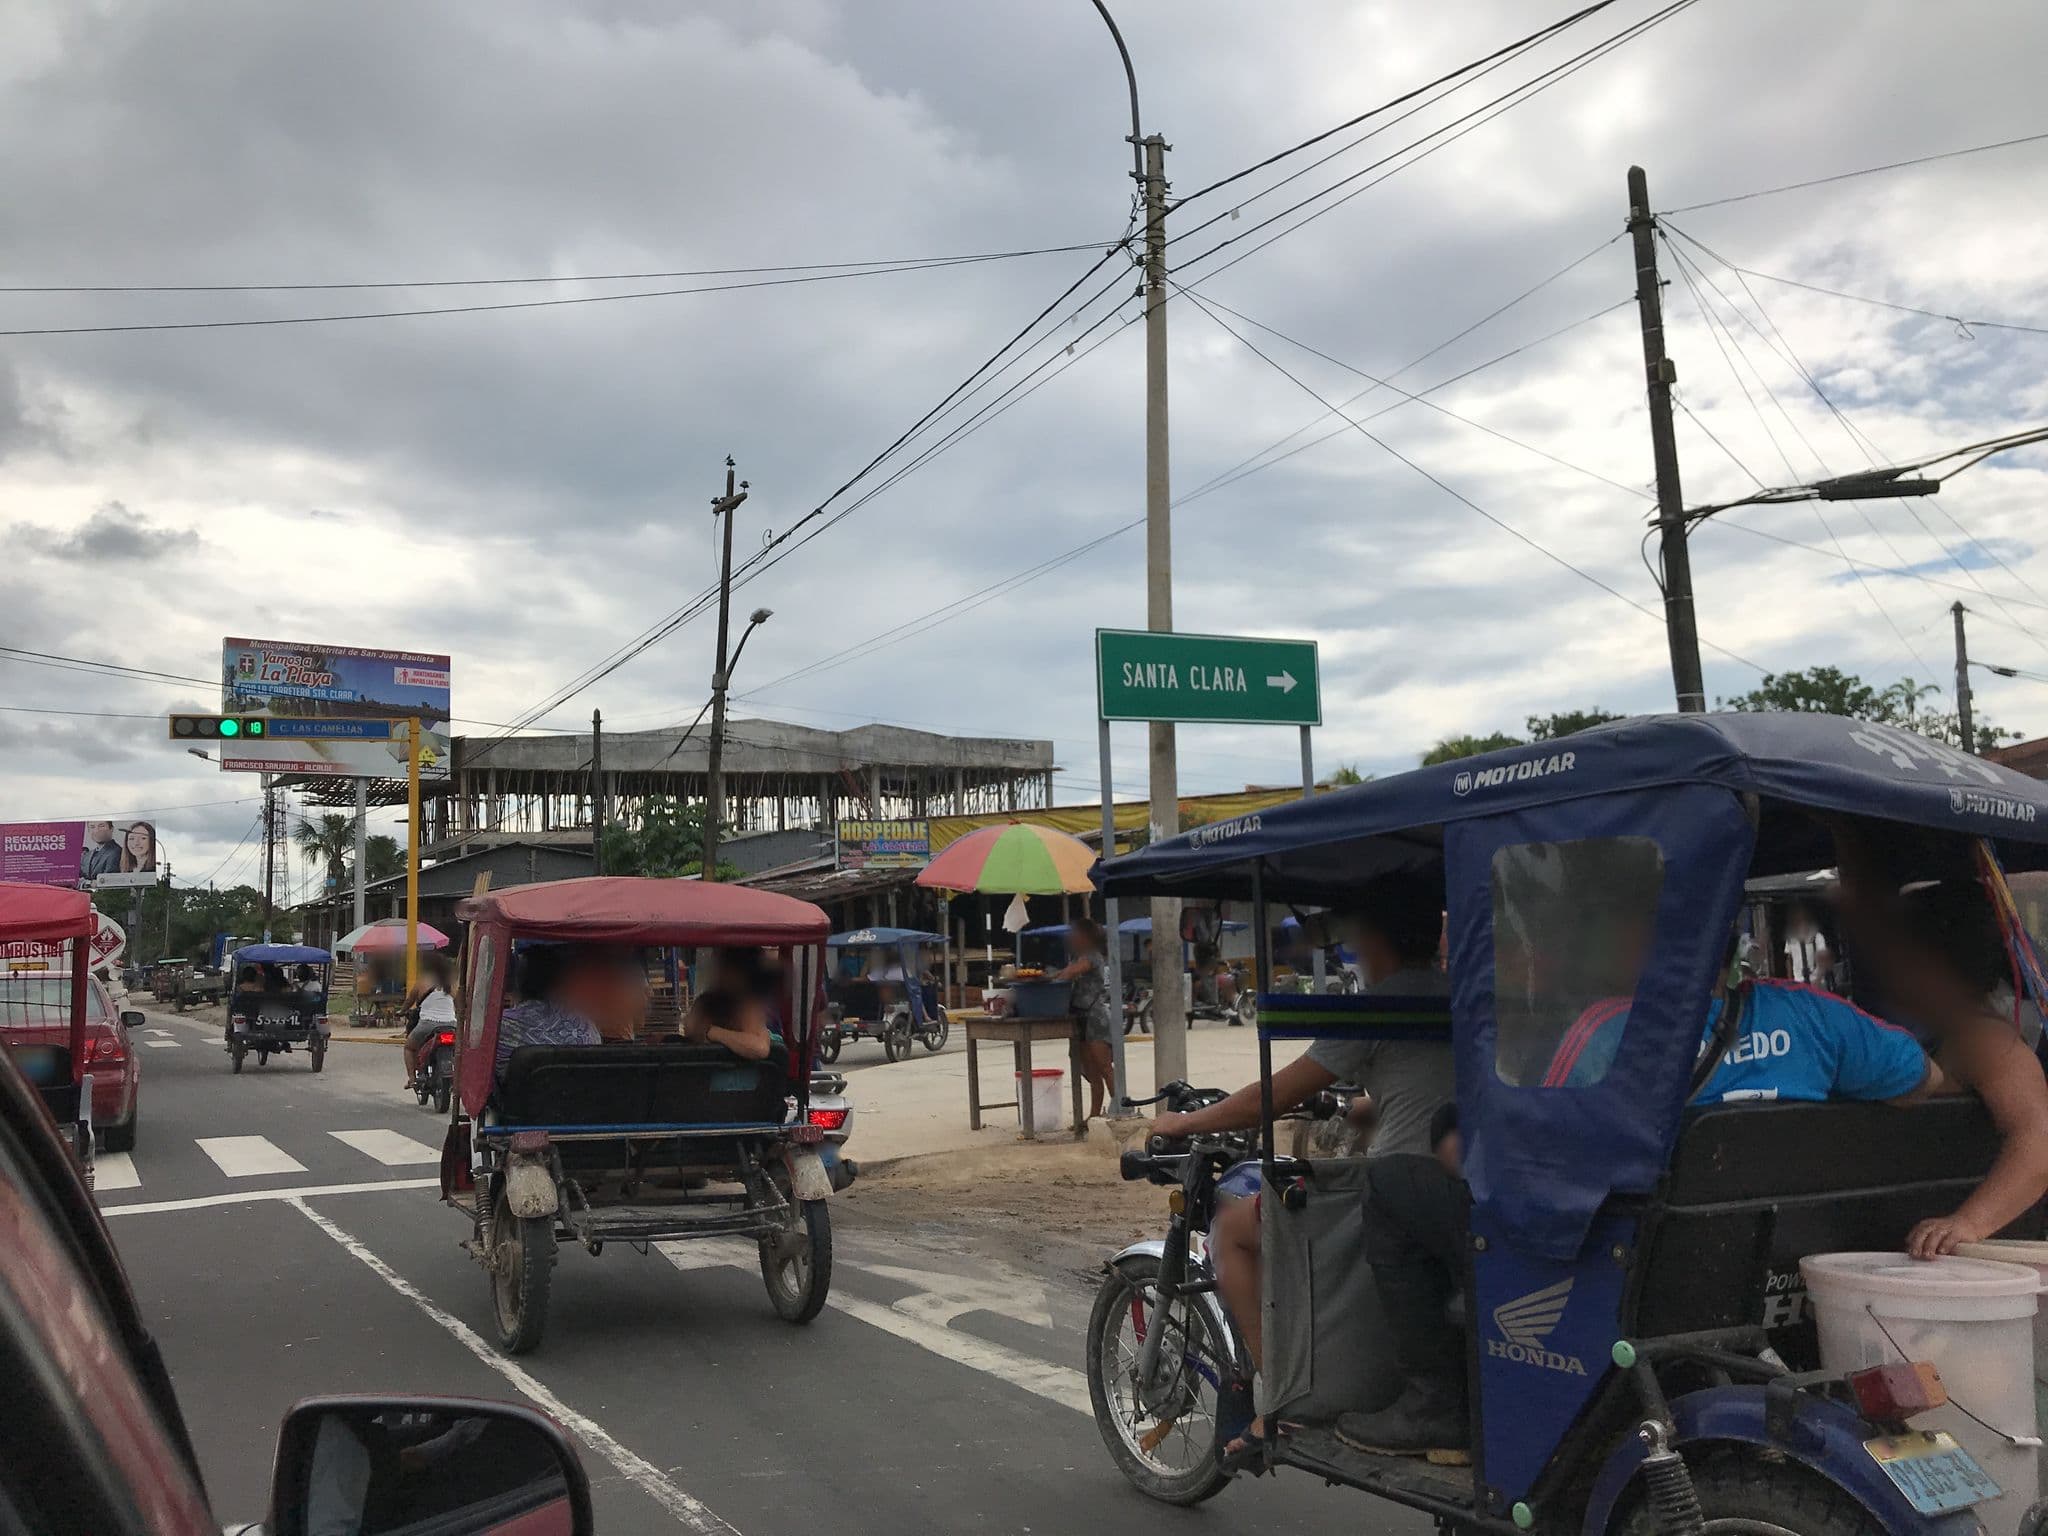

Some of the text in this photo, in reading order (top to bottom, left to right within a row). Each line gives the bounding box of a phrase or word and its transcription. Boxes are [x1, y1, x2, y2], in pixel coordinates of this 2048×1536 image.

[249, 640, 310, 652] Municipalidad
[312, 645, 346, 655] Distrital
[360, 649, 376, 657] San
[379, 652, 398, 660] Juan
[401, 653, 434, 663] Bautista
[262, 650, 312, 667] Vamos a
[260, 663, 333, 688] La Playa
[1122, 662, 1247, 693] SANTA CLARA
[241, 684, 257, 693] POR
[270, 686, 310, 697] CARRETERA
[330, 690, 352, 700] CLARA
[293, 724, 311, 732] LAS
[314, 725, 363, 734] CAMELIAS
[225, 761, 263, 769] FRANCISCO
[265, 762, 298, 771] SANJURJO
[304, 764, 333, 772] ALCALDE
[1474, 751, 1576, 789] MOTOKAR
[1966, 793, 2036, 822] MOTOKAR
[4, 834, 66, 844] RECURSOS
[840, 821, 928, 840] HOSPEDAJE
[1202, 816, 1262, 845] MOTOKAR
[4, 842, 66, 852] HUMANOS
[1487, 1339, 1588, 1376] HONDA
